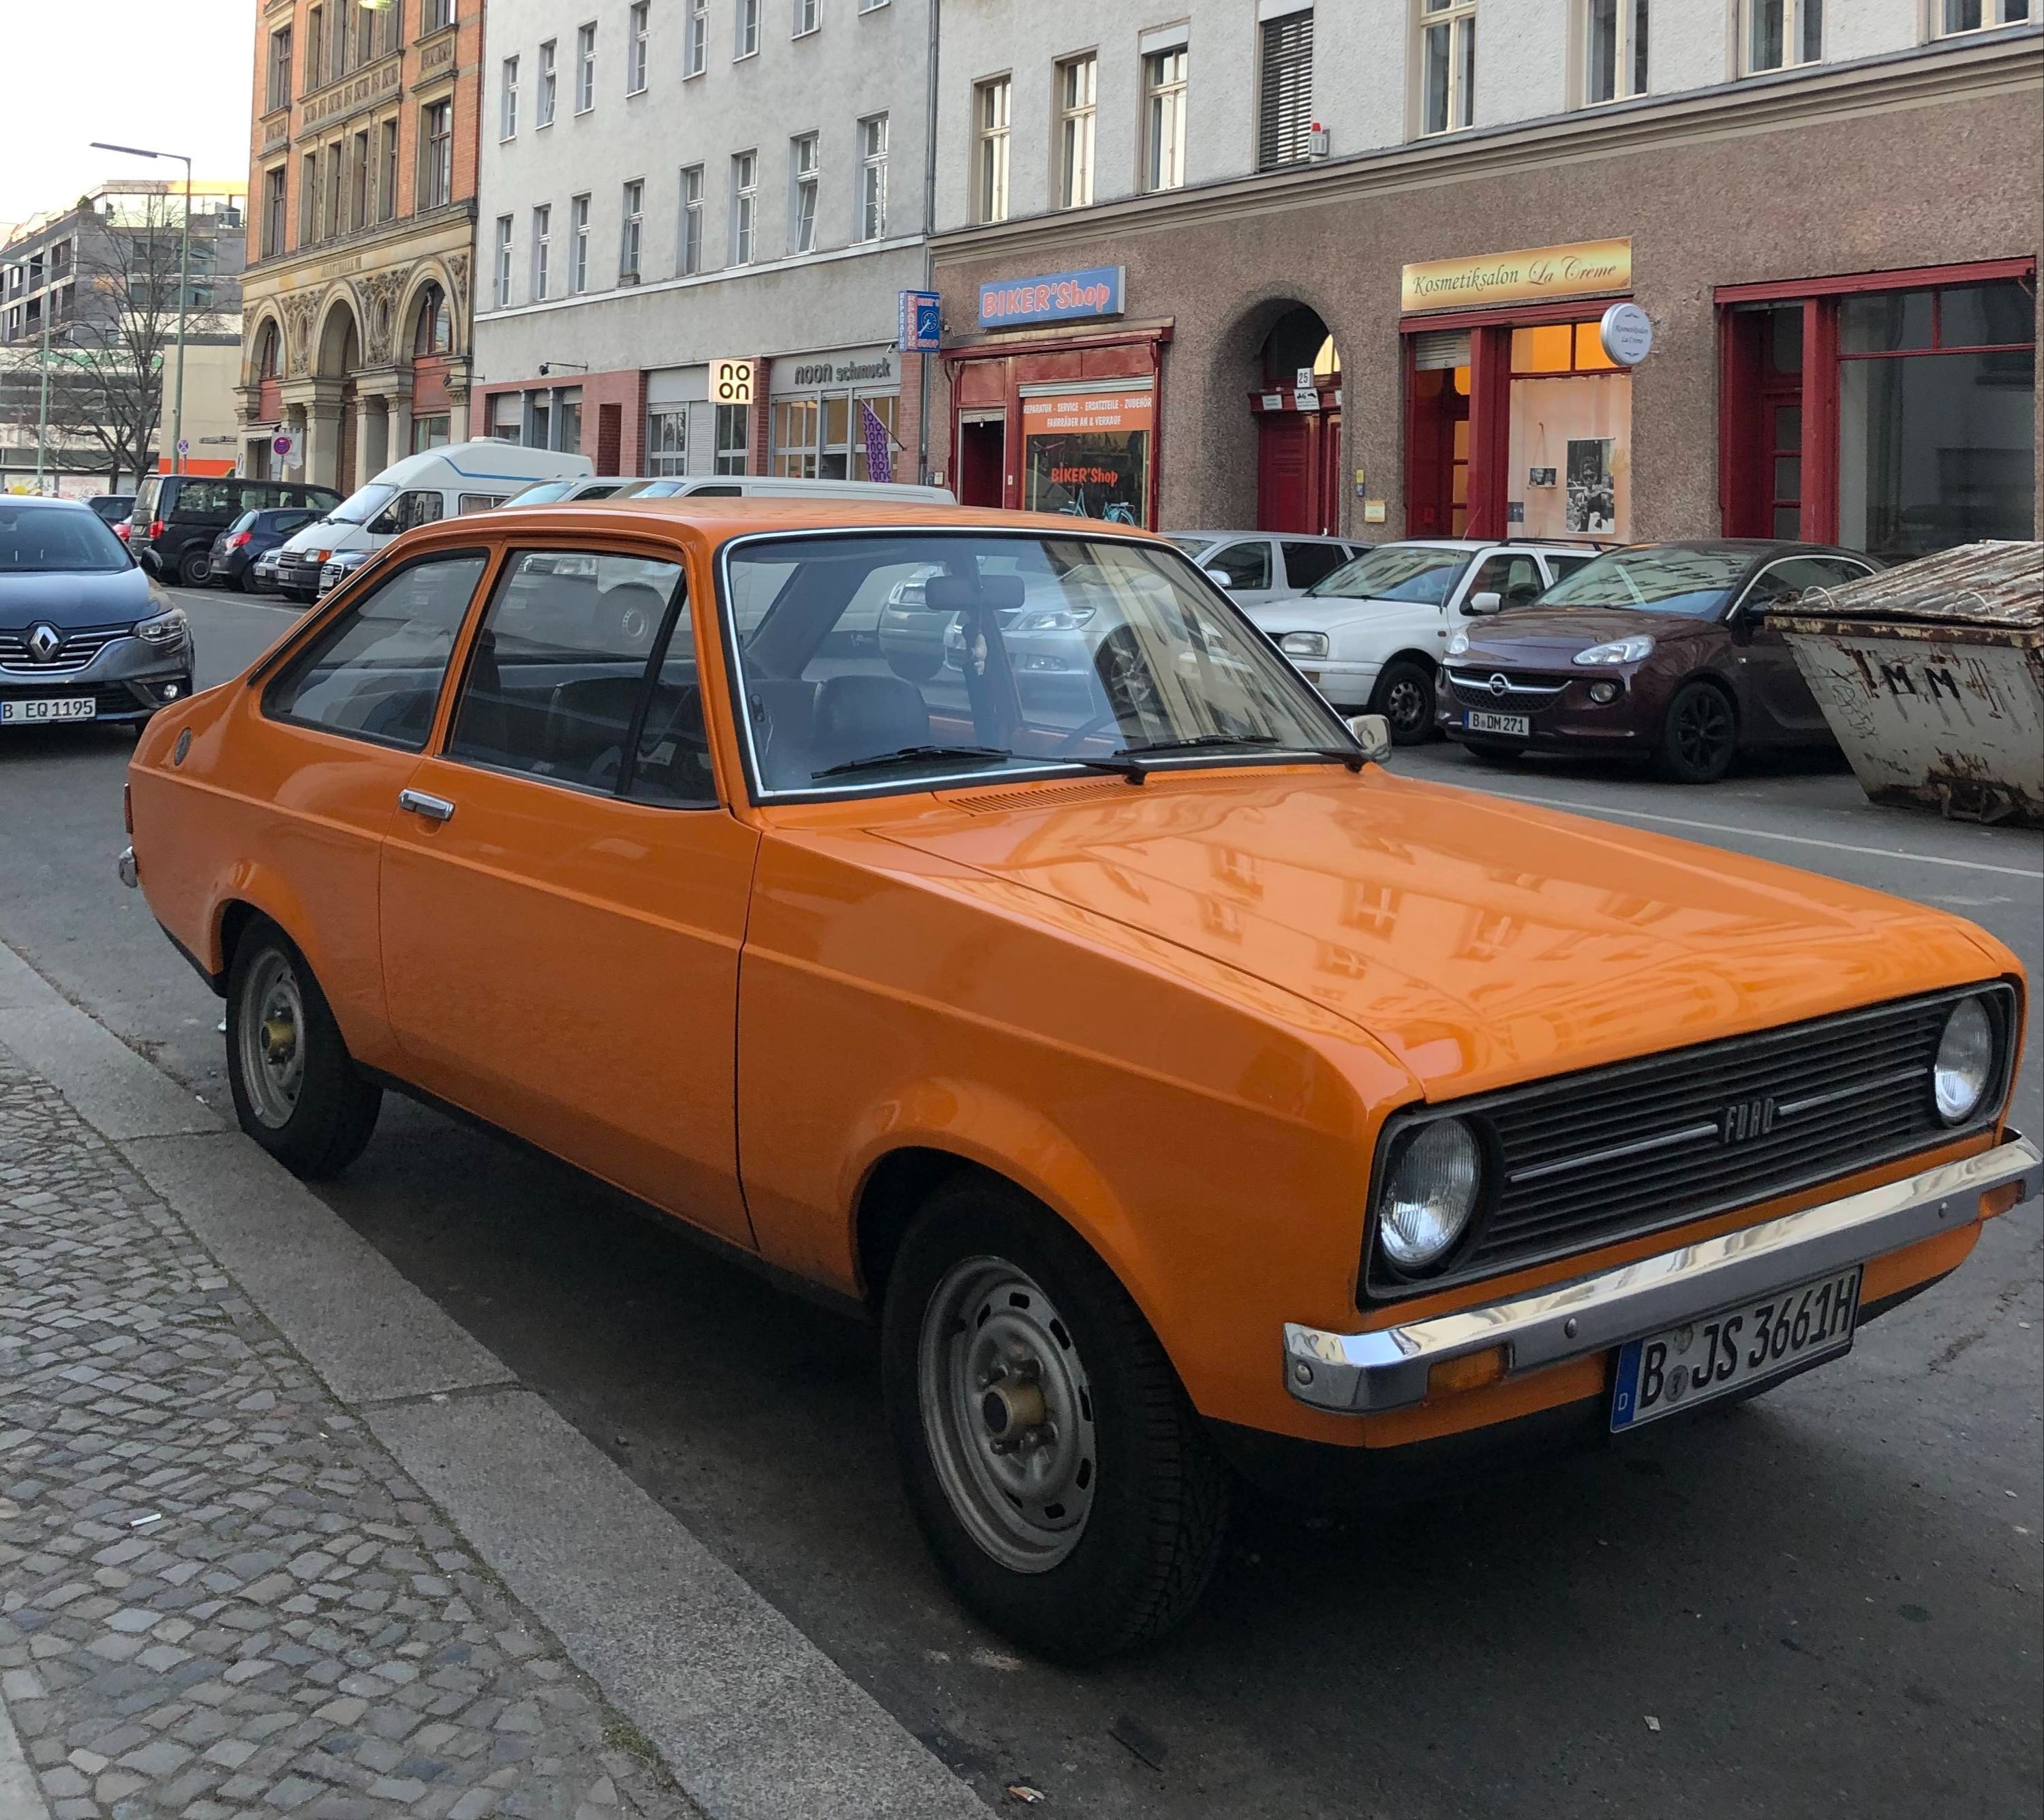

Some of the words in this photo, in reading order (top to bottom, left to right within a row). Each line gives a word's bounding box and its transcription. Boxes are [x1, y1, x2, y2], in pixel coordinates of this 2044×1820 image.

[1413, 264, 1519, 296] Kosmetiksalon
[1526, 260, 1553, 286] La
[908, 295, 916, 348] REPARATUR
[720, 364, 750, 381] no
[795, 363, 833, 385] noon
[836, 358, 891, 381] schmuck
[1298, 372, 1308, 384] 25
[719, 383, 749, 400] on
[1024, 404, 1052, 414] REPARATUR
[1057, 402, 1078, 412] SERVICE
[1085, 399, 1118, 412] ERSATZTEILE
[1124, 396, 1152, 409] ZUBEHÖR
[1047, 416, 1079, 428] FAHRRÄDER
[1080, 417, 1087, 427] AN
[1090, 417, 1094, 427] &
[1095, 415, 1121, 426] VERKAUF
[3, 704, 13, 719] B
[26, 703, 48, 718] EQ
[52, 700, 93, 716] 1195
[1473, 713, 1479, 727] B
[1486, 715, 1501, 730] DM
[1504, 717, 1524, 733] 271
[1724, 1098, 1774, 1143] FORD
[1640, 1341, 1667, 1409] B
[1692, 1315, 1743, 1389] JS
[1748, 1274, 1856, 1368] 3661H
[1618, 1392, 1628, 1412] D
